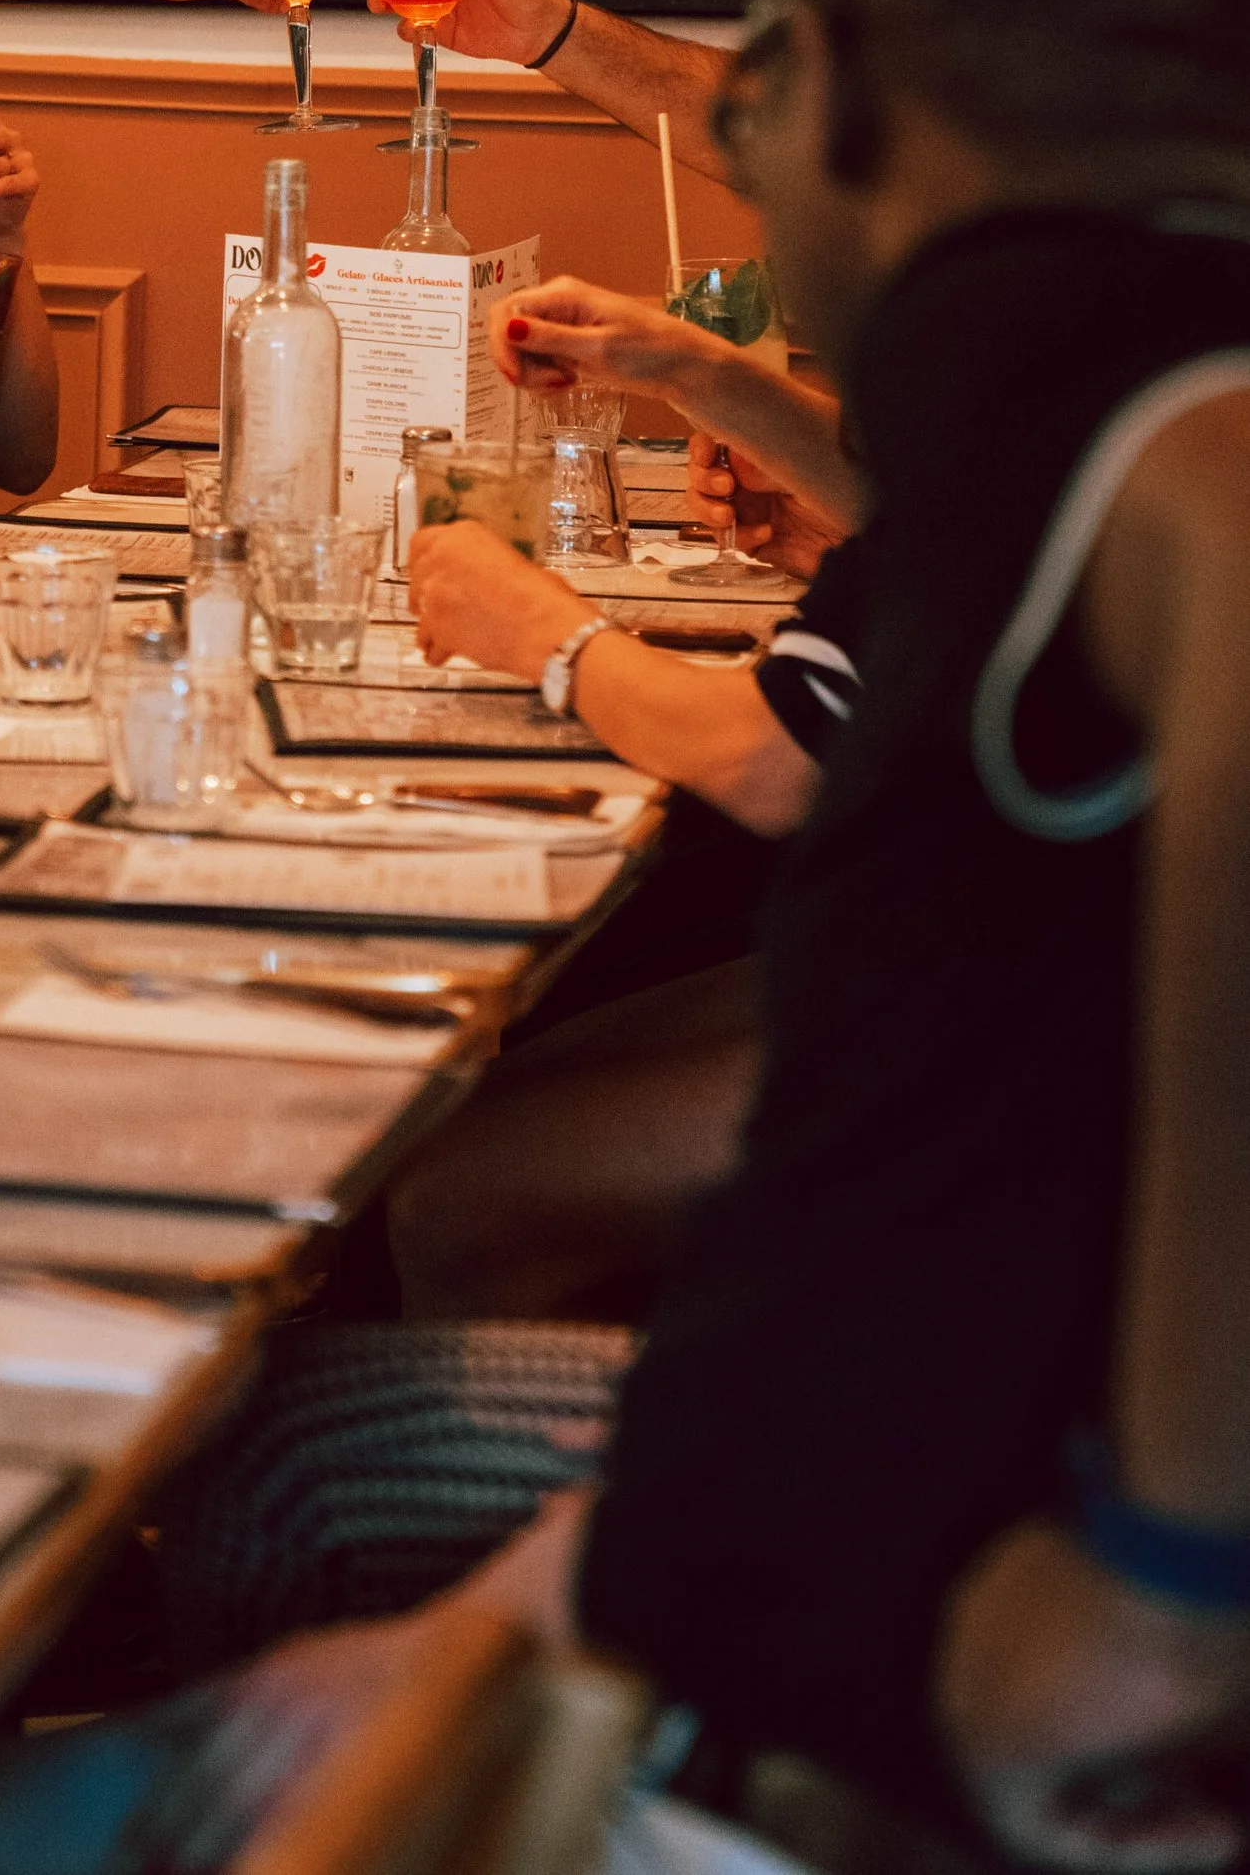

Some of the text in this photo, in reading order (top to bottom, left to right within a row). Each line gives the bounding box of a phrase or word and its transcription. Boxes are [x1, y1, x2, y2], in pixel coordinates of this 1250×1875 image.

[337, 268, 464, 289] Gelato Glaces Artisanales
